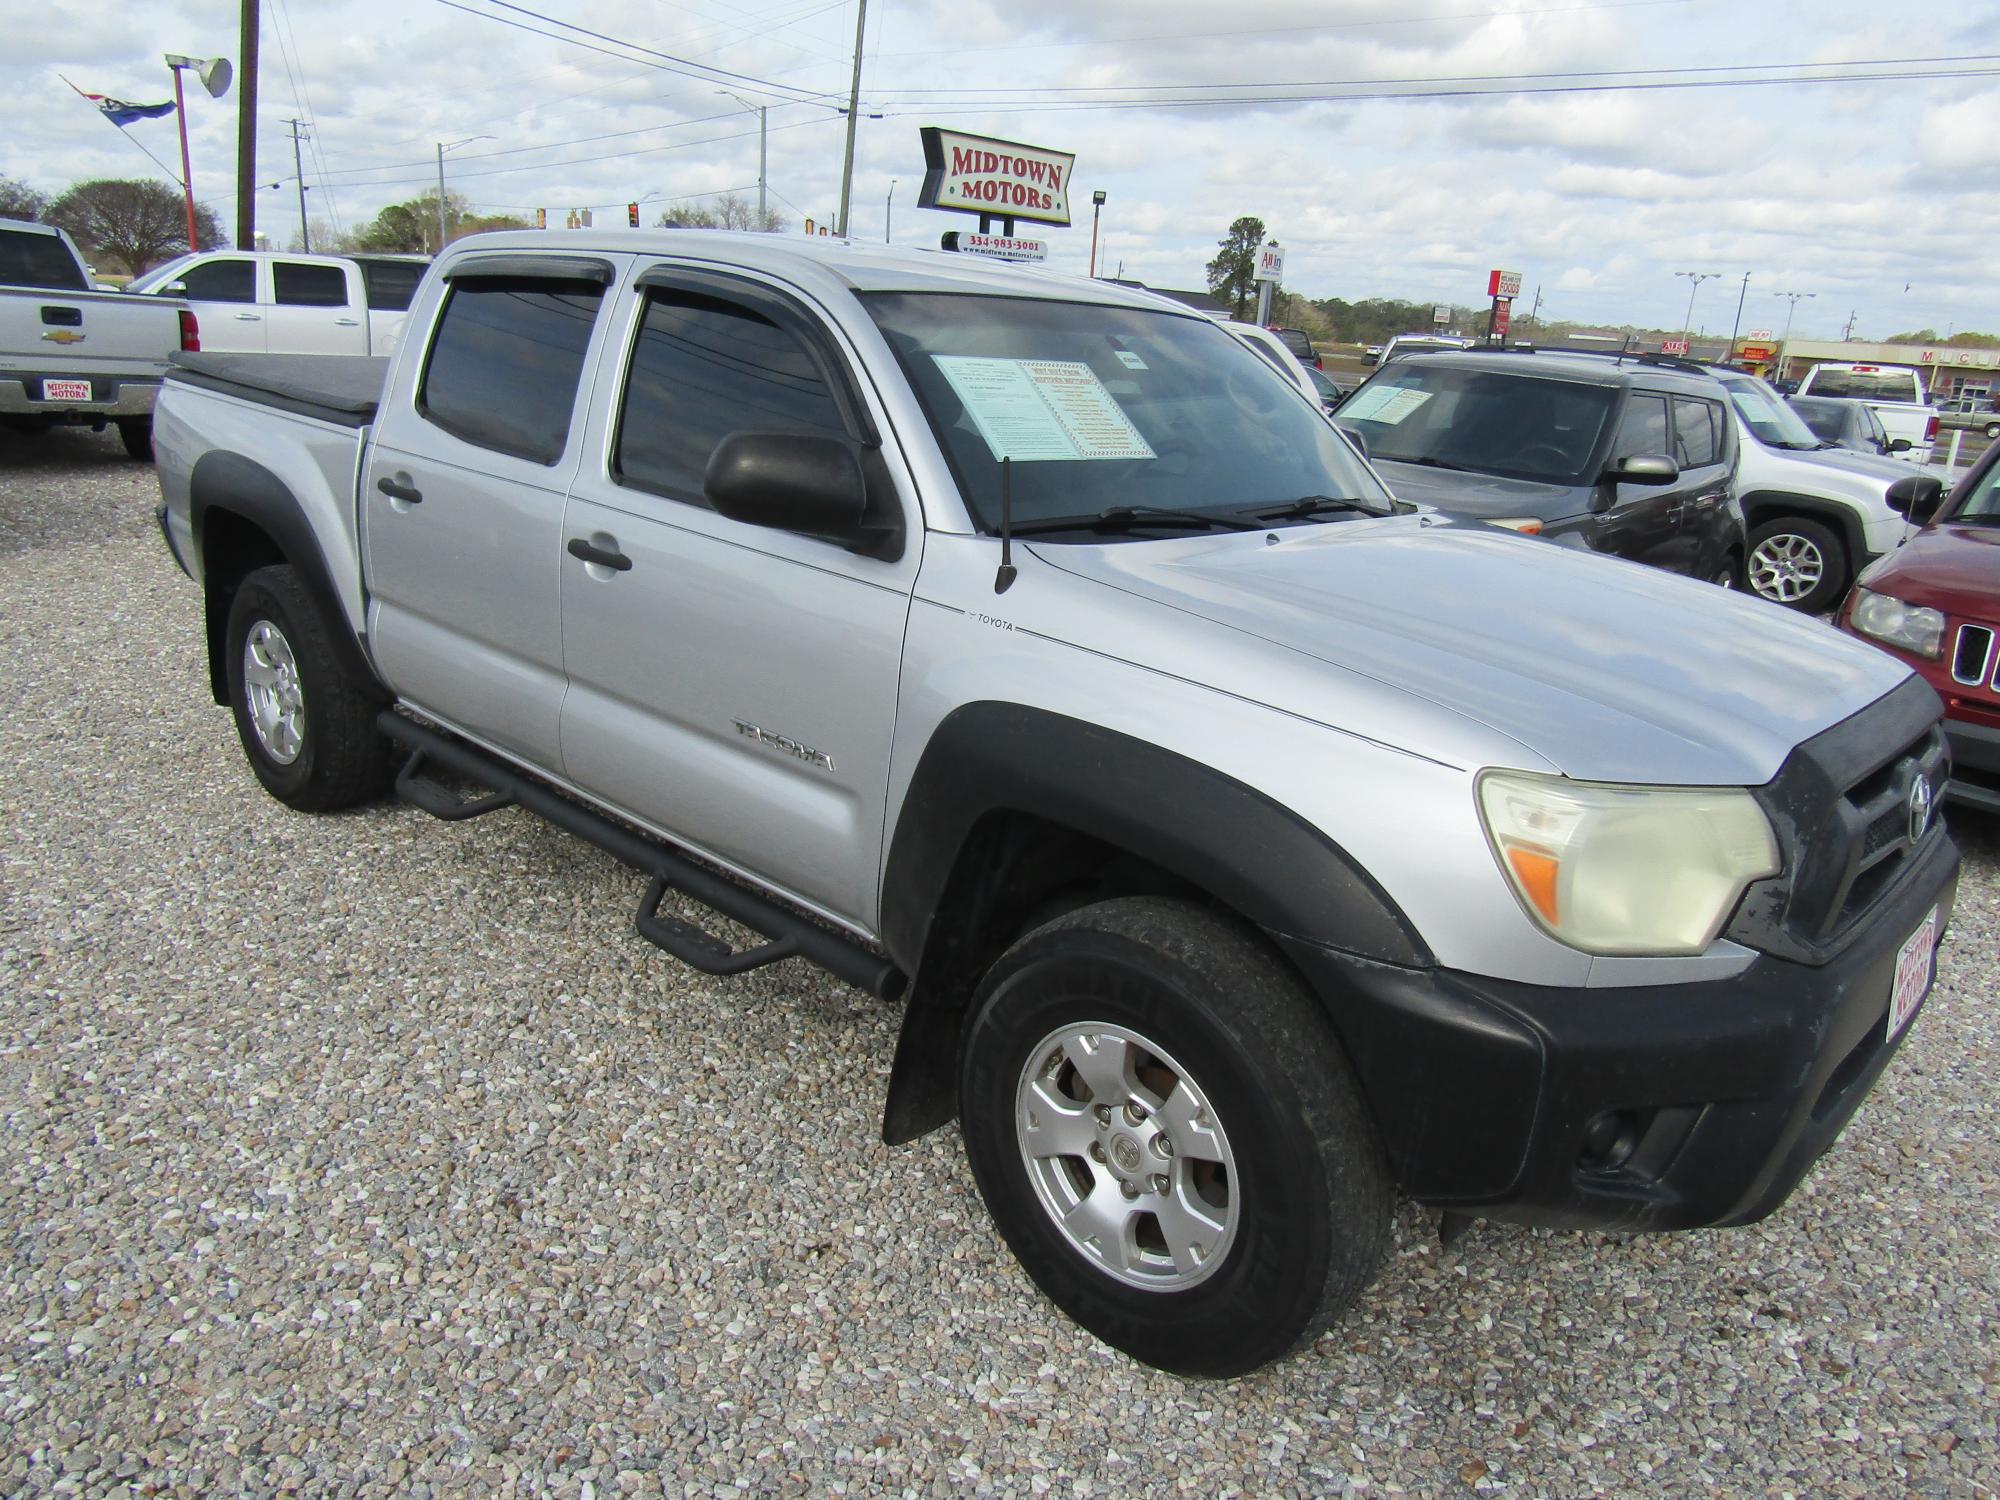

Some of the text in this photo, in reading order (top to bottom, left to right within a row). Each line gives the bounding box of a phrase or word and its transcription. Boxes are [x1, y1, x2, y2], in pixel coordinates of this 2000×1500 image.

[951, 146, 1063, 193] MIDTOWN
[961, 180, 1052, 210] MOTORS
[1500, 282, 1520, 294] FOODS
[47, 383, 89, 391] MIDTOWN
[50, 390, 87, 399] MOTORS
[977, 613, 1014, 632] TOYOTA
[729, 715, 837, 774] TACOMA
